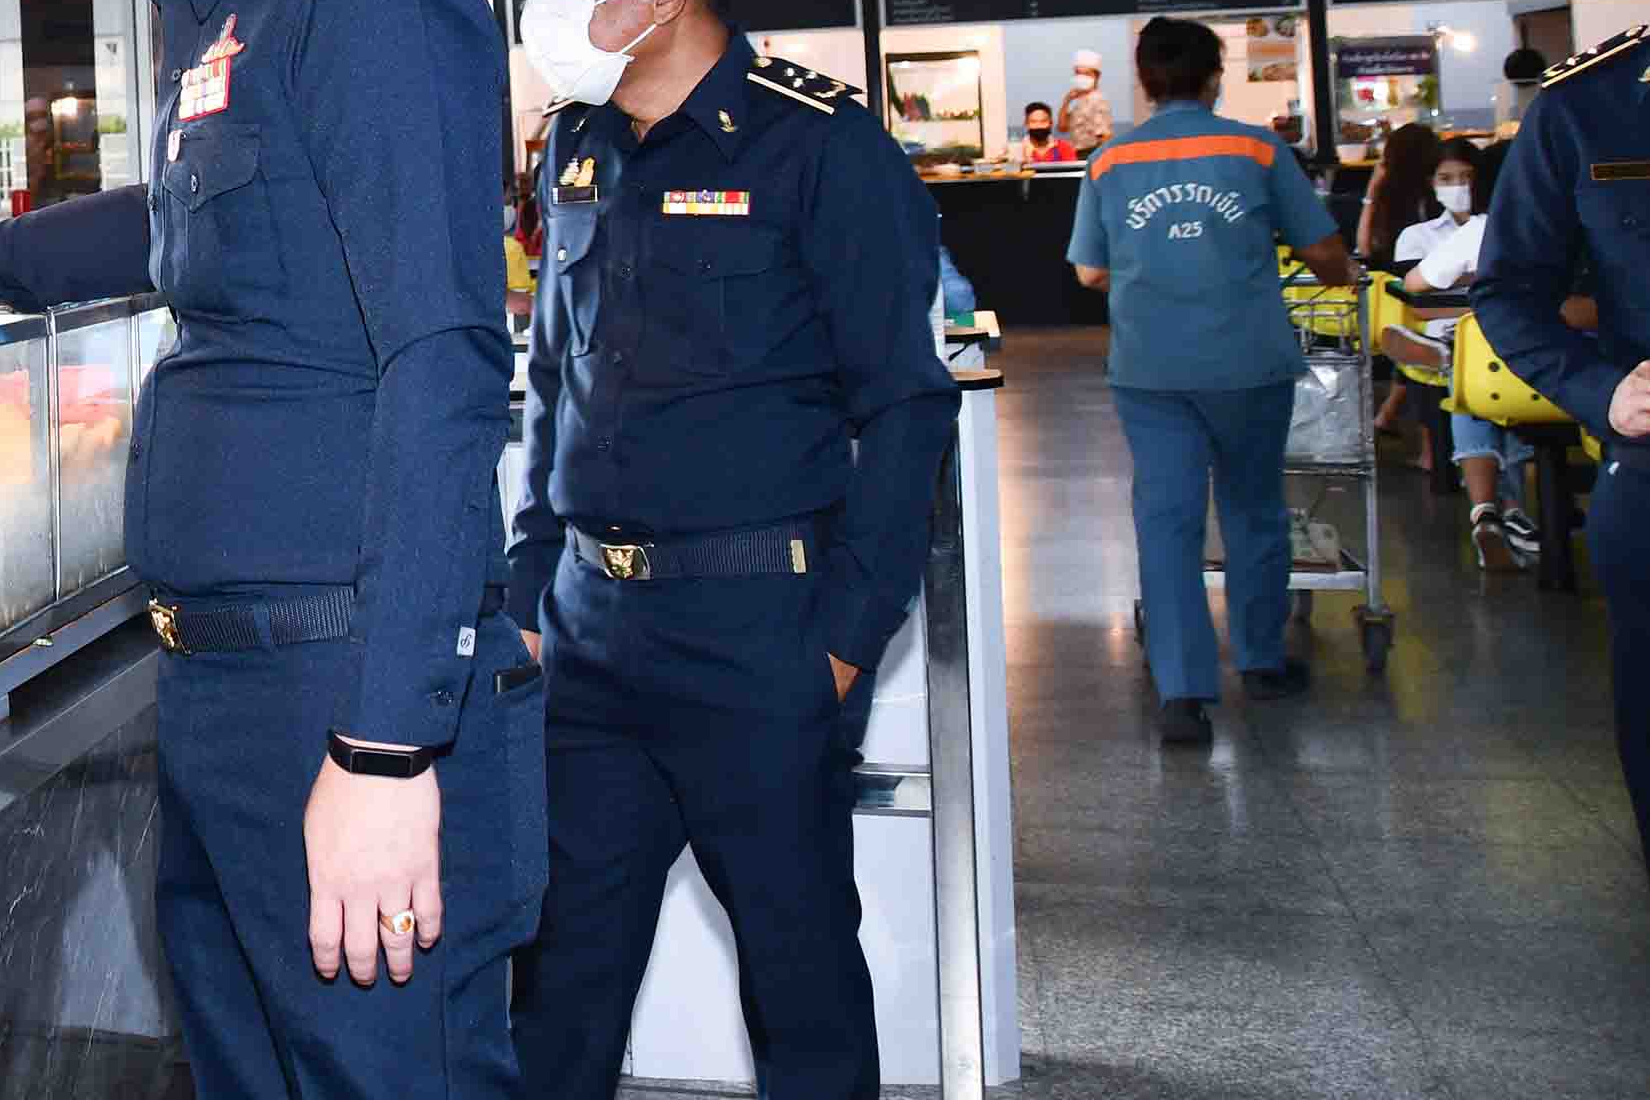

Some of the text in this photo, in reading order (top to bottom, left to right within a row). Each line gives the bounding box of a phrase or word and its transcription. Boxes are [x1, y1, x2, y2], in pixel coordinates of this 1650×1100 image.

[1126, 182, 1244, 229] บริการรถเข็น
[1168, 221, 1204, 240] A25
